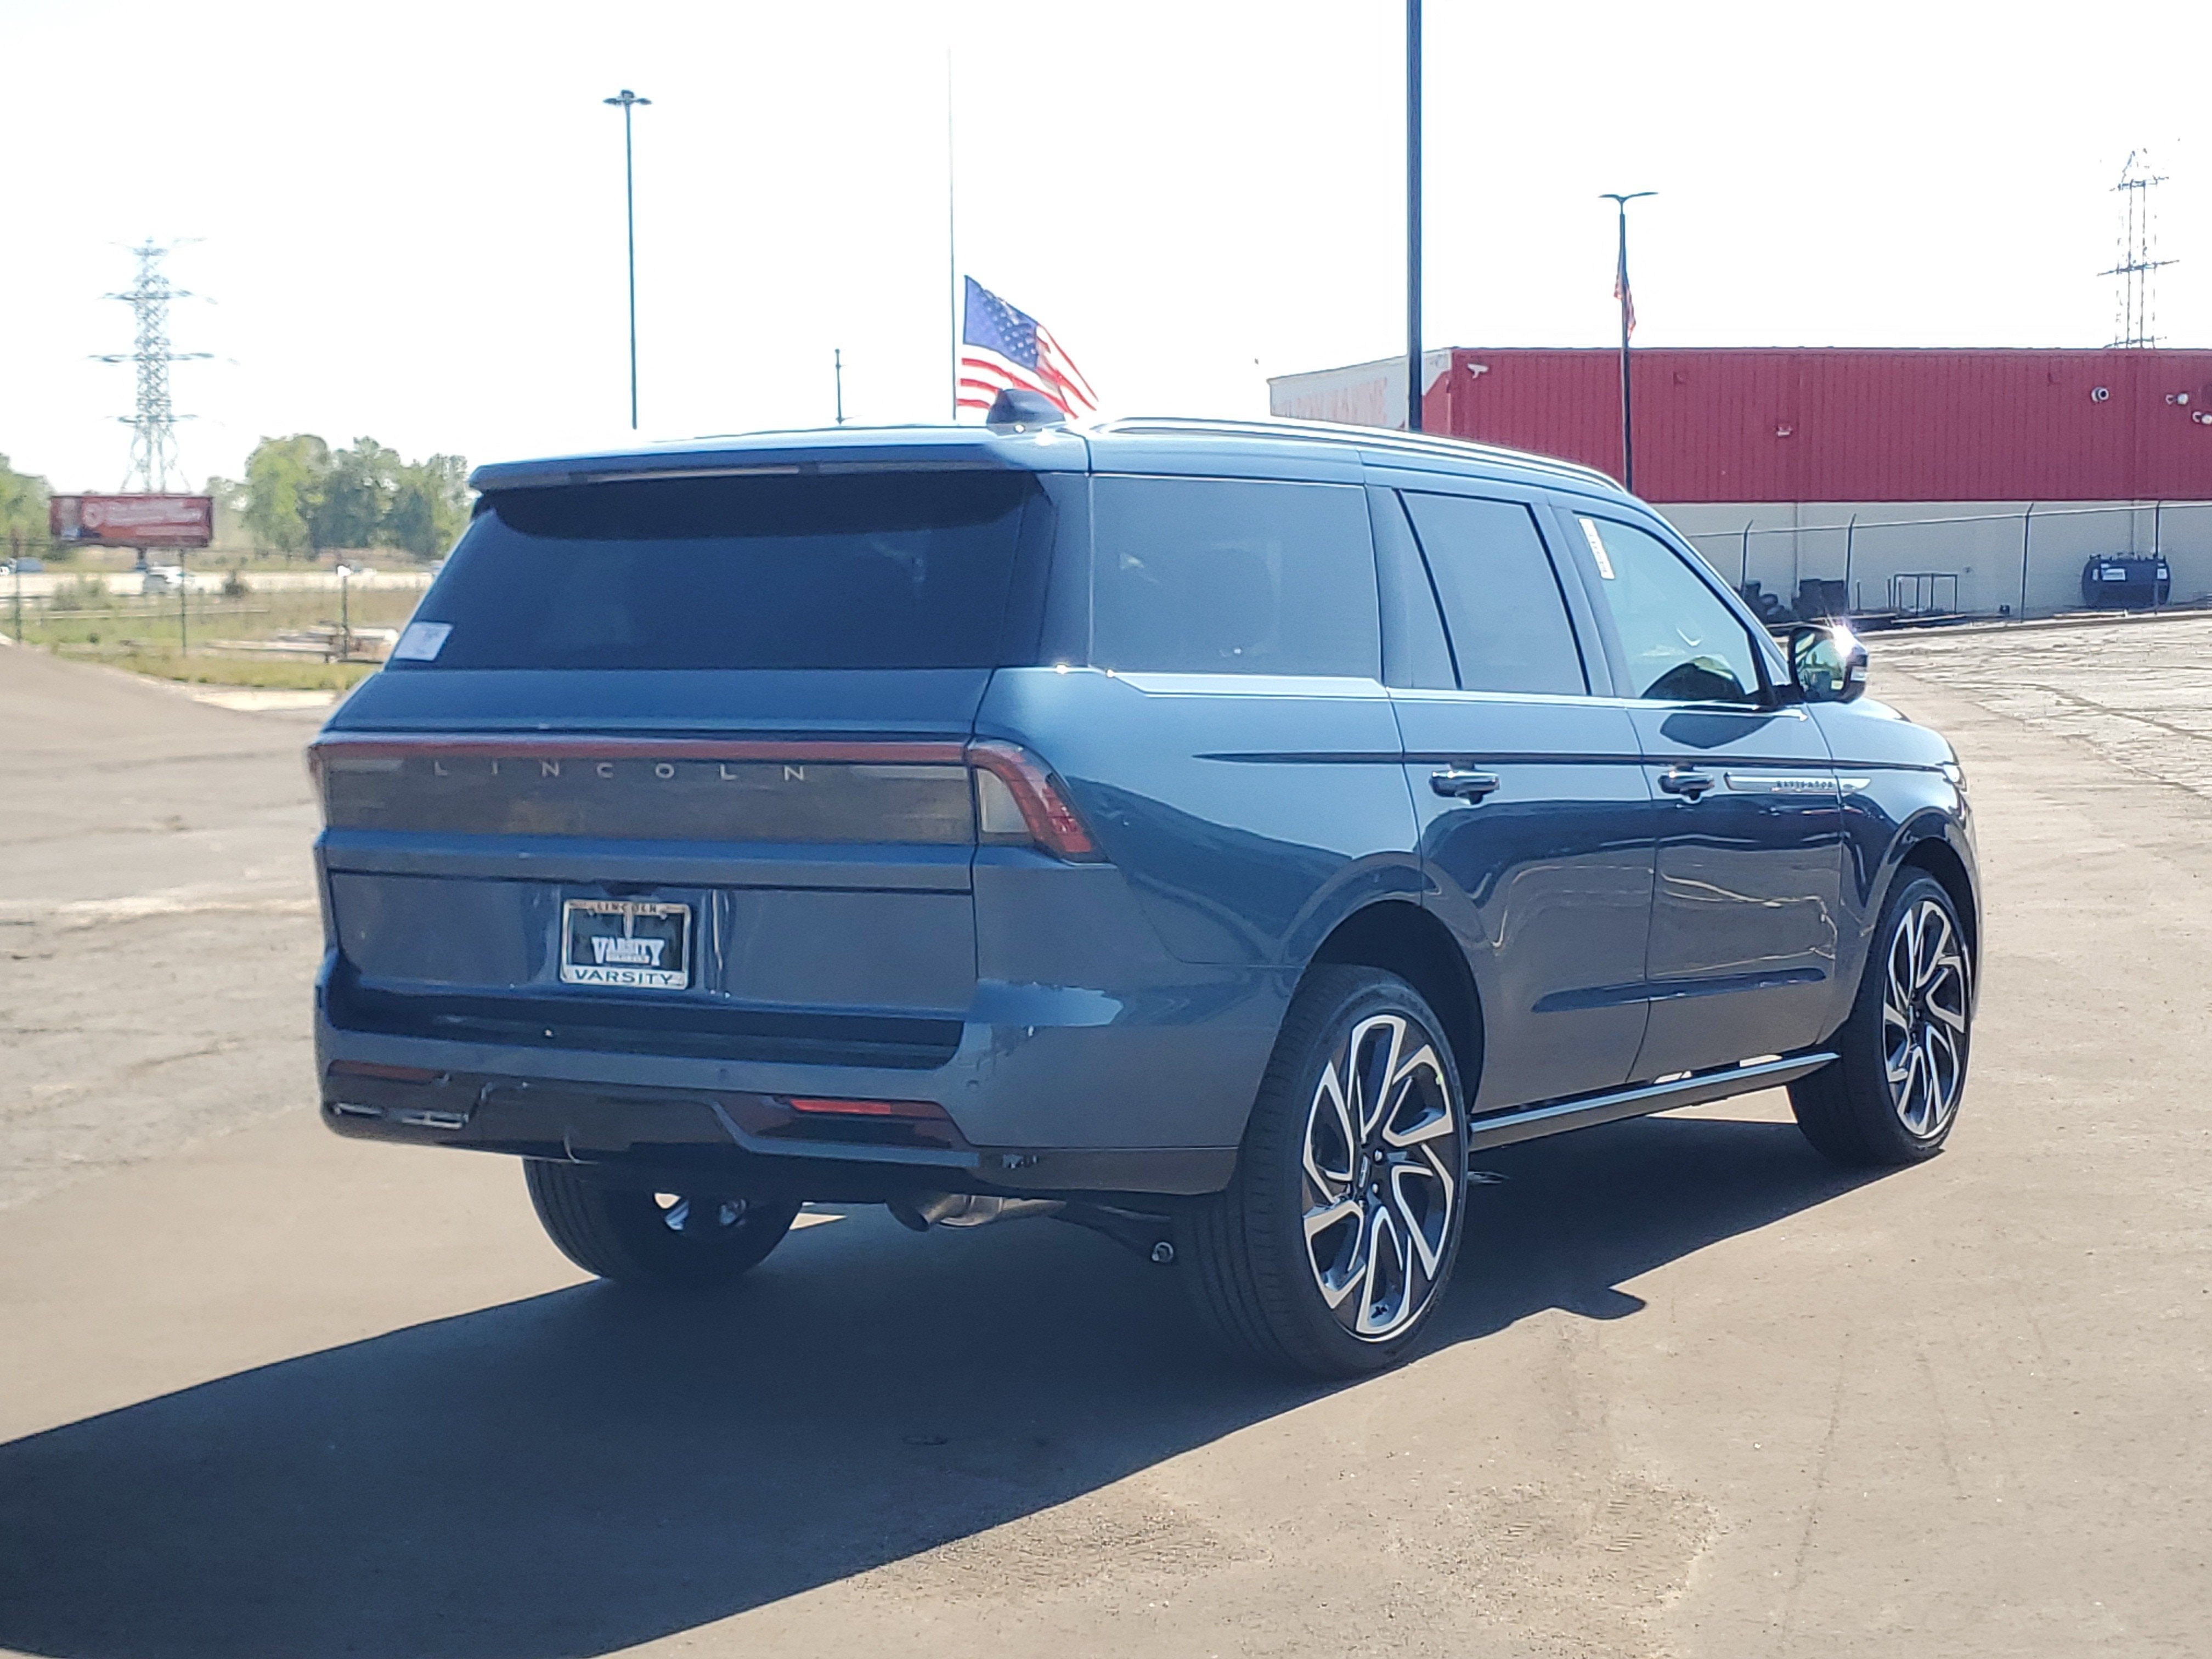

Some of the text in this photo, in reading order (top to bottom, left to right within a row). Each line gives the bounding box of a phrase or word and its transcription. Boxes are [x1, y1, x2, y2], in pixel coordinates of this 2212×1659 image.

[433, 761, 805, 781] LINCOLN
[591, 936, 665, 966] VARSITY
[575, 969, 673, 985] VARSITY
